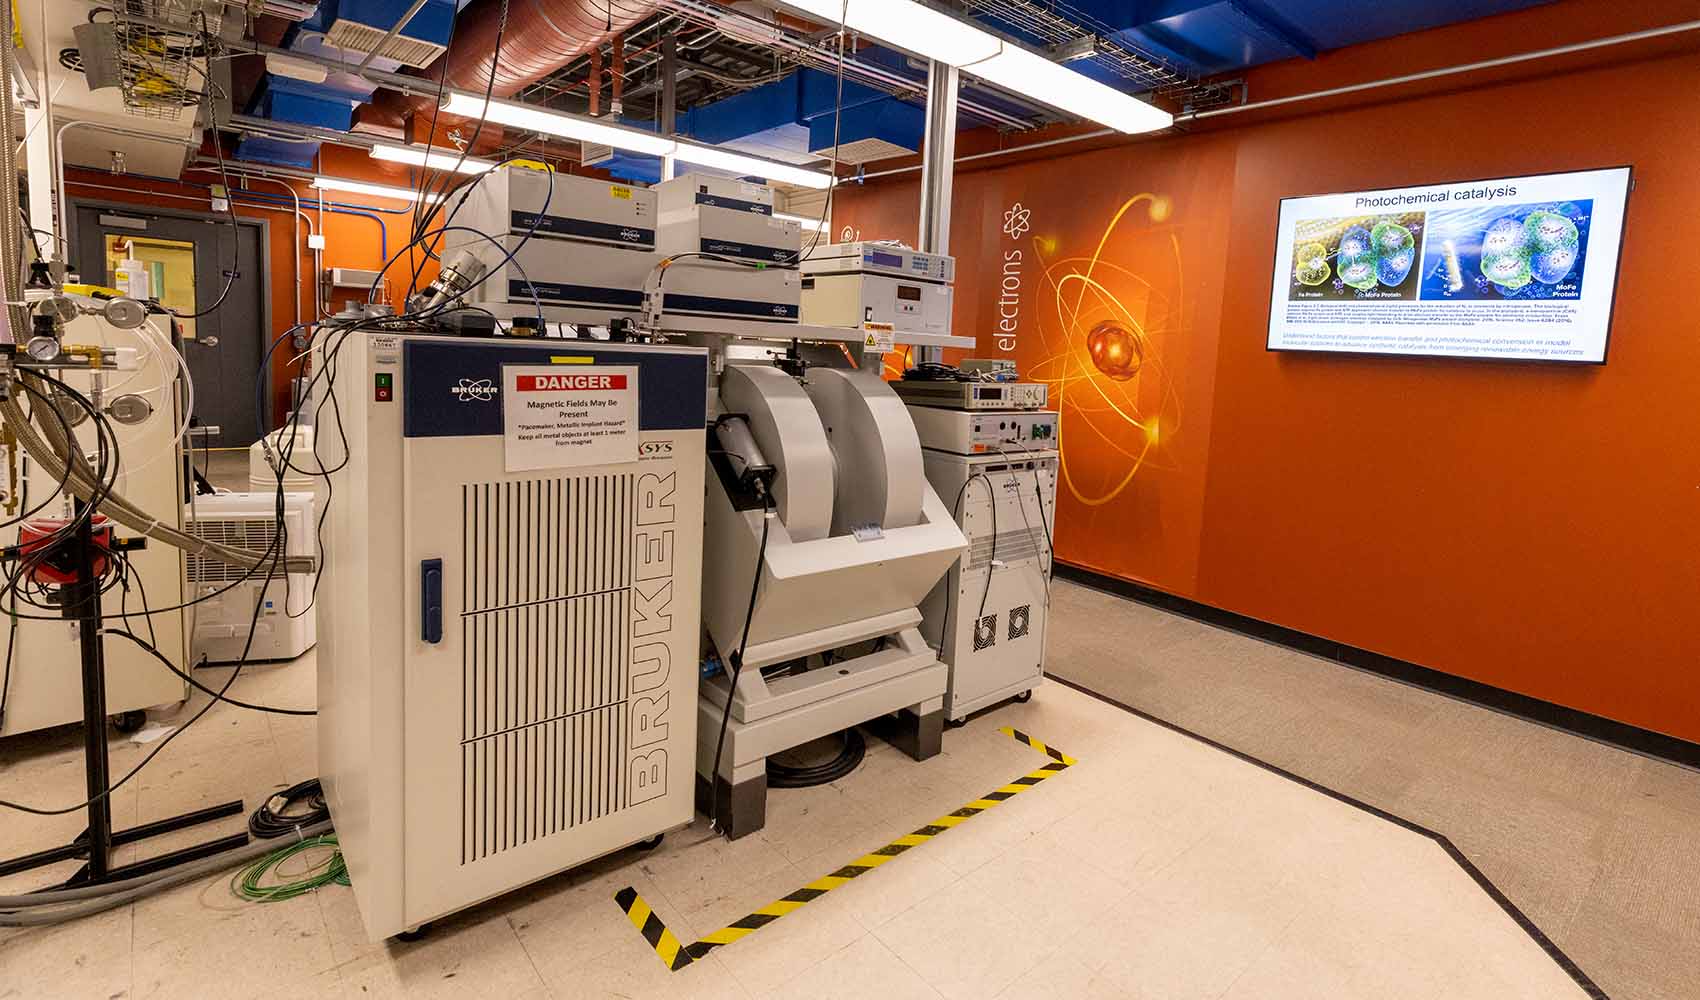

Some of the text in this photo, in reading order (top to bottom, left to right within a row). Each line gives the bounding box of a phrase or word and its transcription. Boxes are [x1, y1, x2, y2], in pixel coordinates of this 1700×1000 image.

[1355, 184, 1517, 208] Photochemical catalysis
[993, 249, 1022, 351] electrons
[535, 376, 612, 389] DANGER
[527, 400, 565, 409] Magnetic
[590, 400, 606, 408] May
[518, 433, 534, 441] Keep
[561, 431, 582, 439] objects
[629, 471, 676, 807] BRUKER
